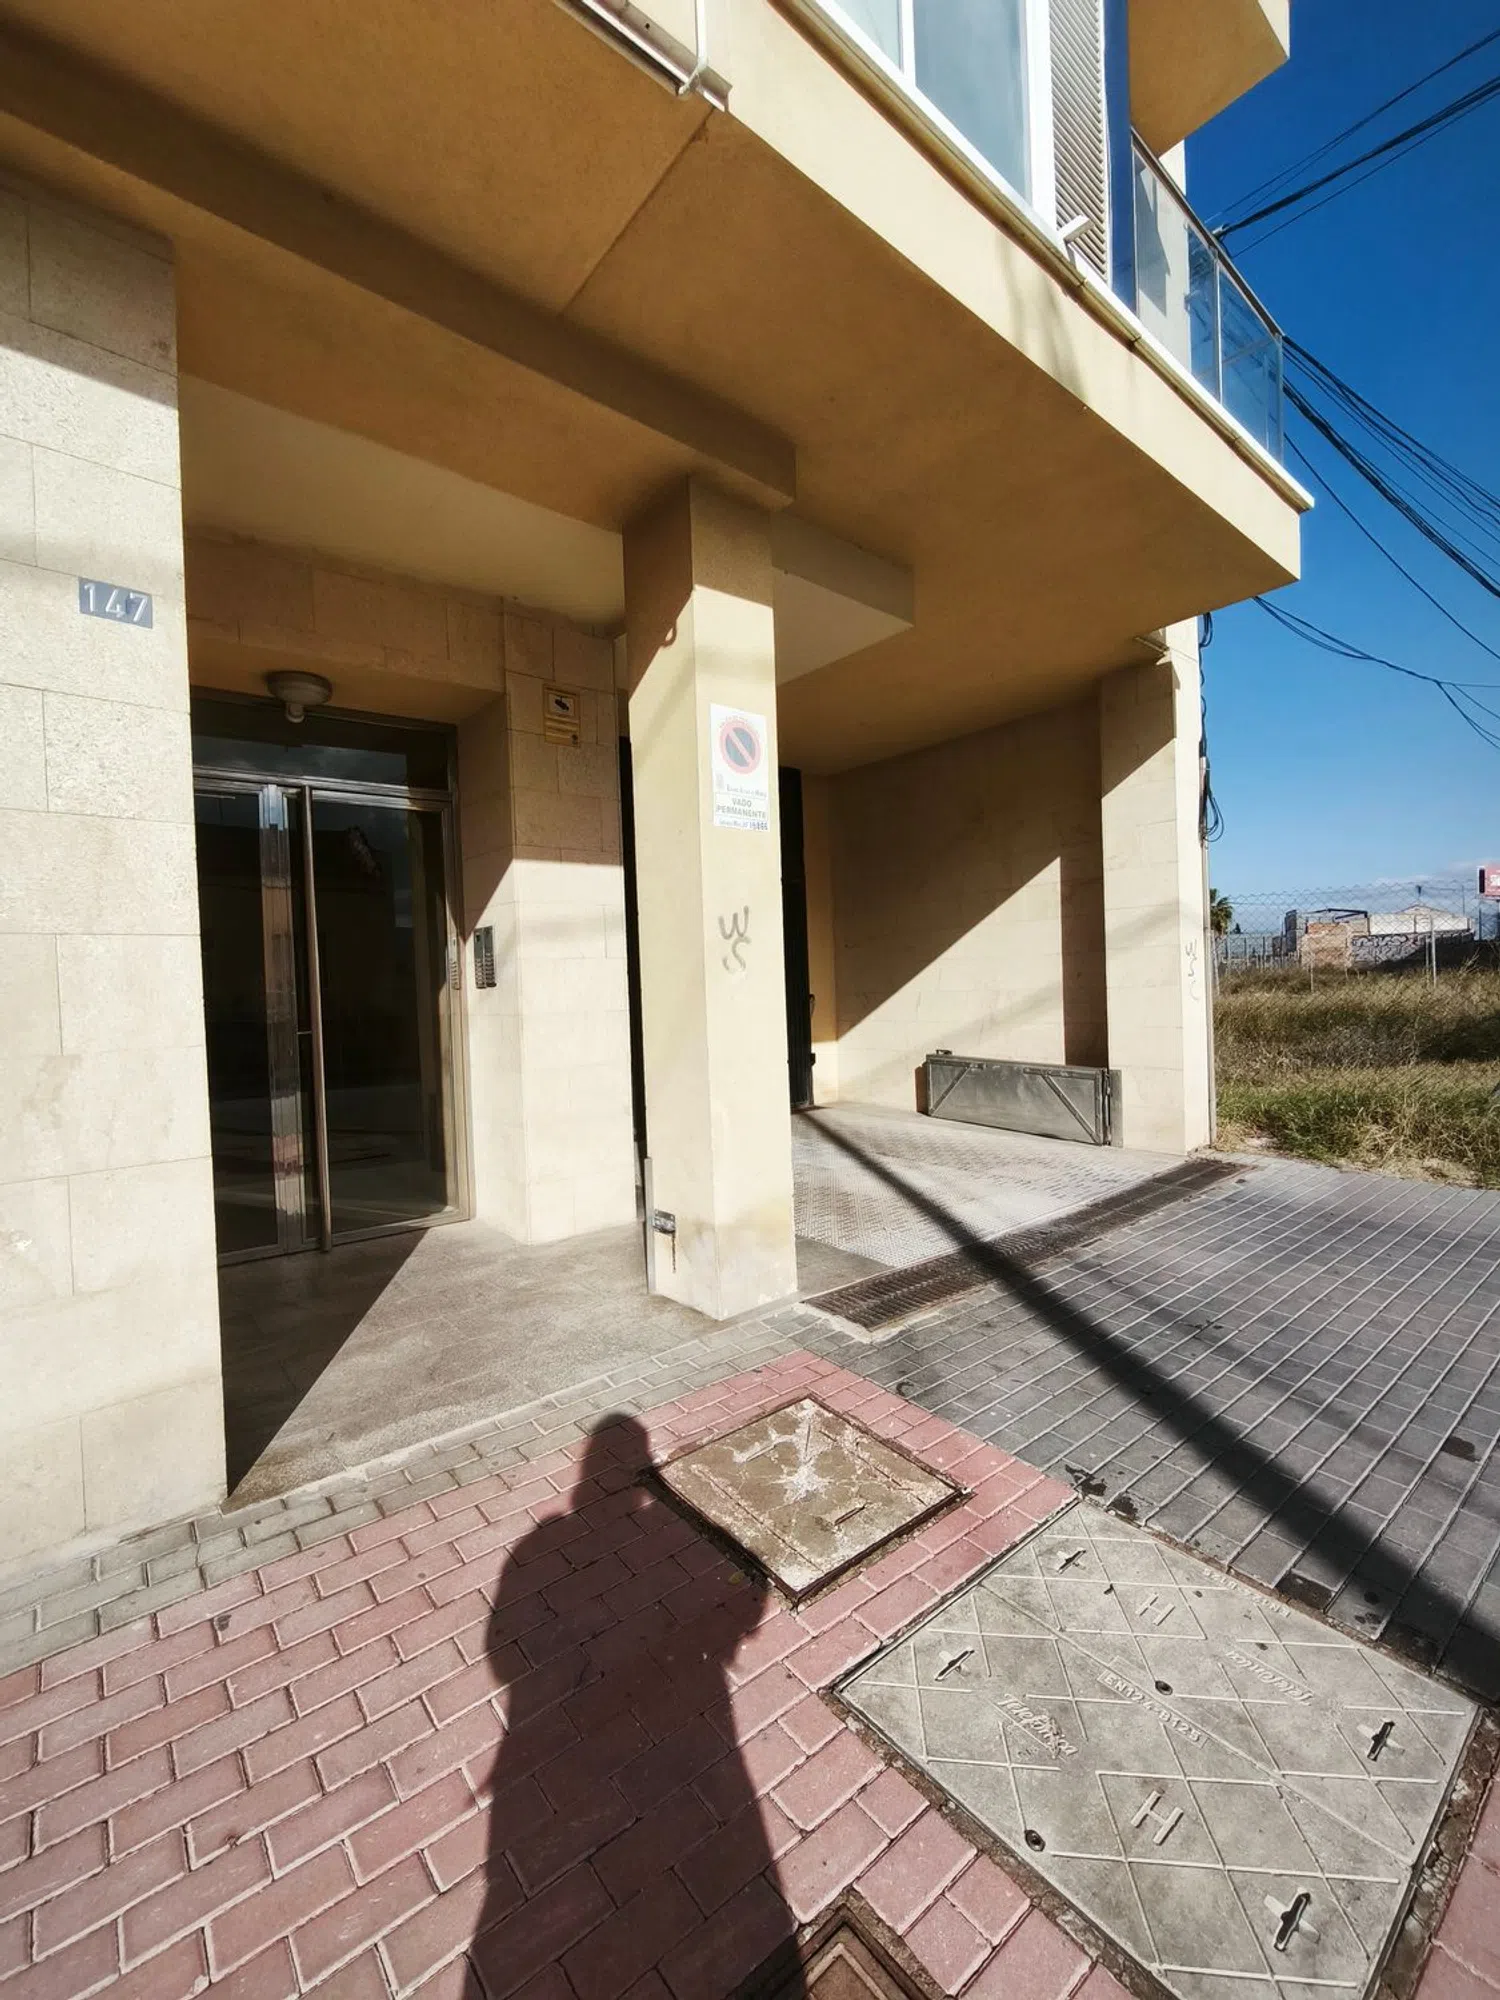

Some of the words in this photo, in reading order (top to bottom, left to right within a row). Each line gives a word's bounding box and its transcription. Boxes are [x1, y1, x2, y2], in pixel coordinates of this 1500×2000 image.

[84, 582, 148, 622] 147
[716, 805, 767, 819] PERMANENTE
[732, 797, 752, 808] VADO
[1135, 1593, 1175, 1626] H
[1131, 1790, 1184, 1846] H
